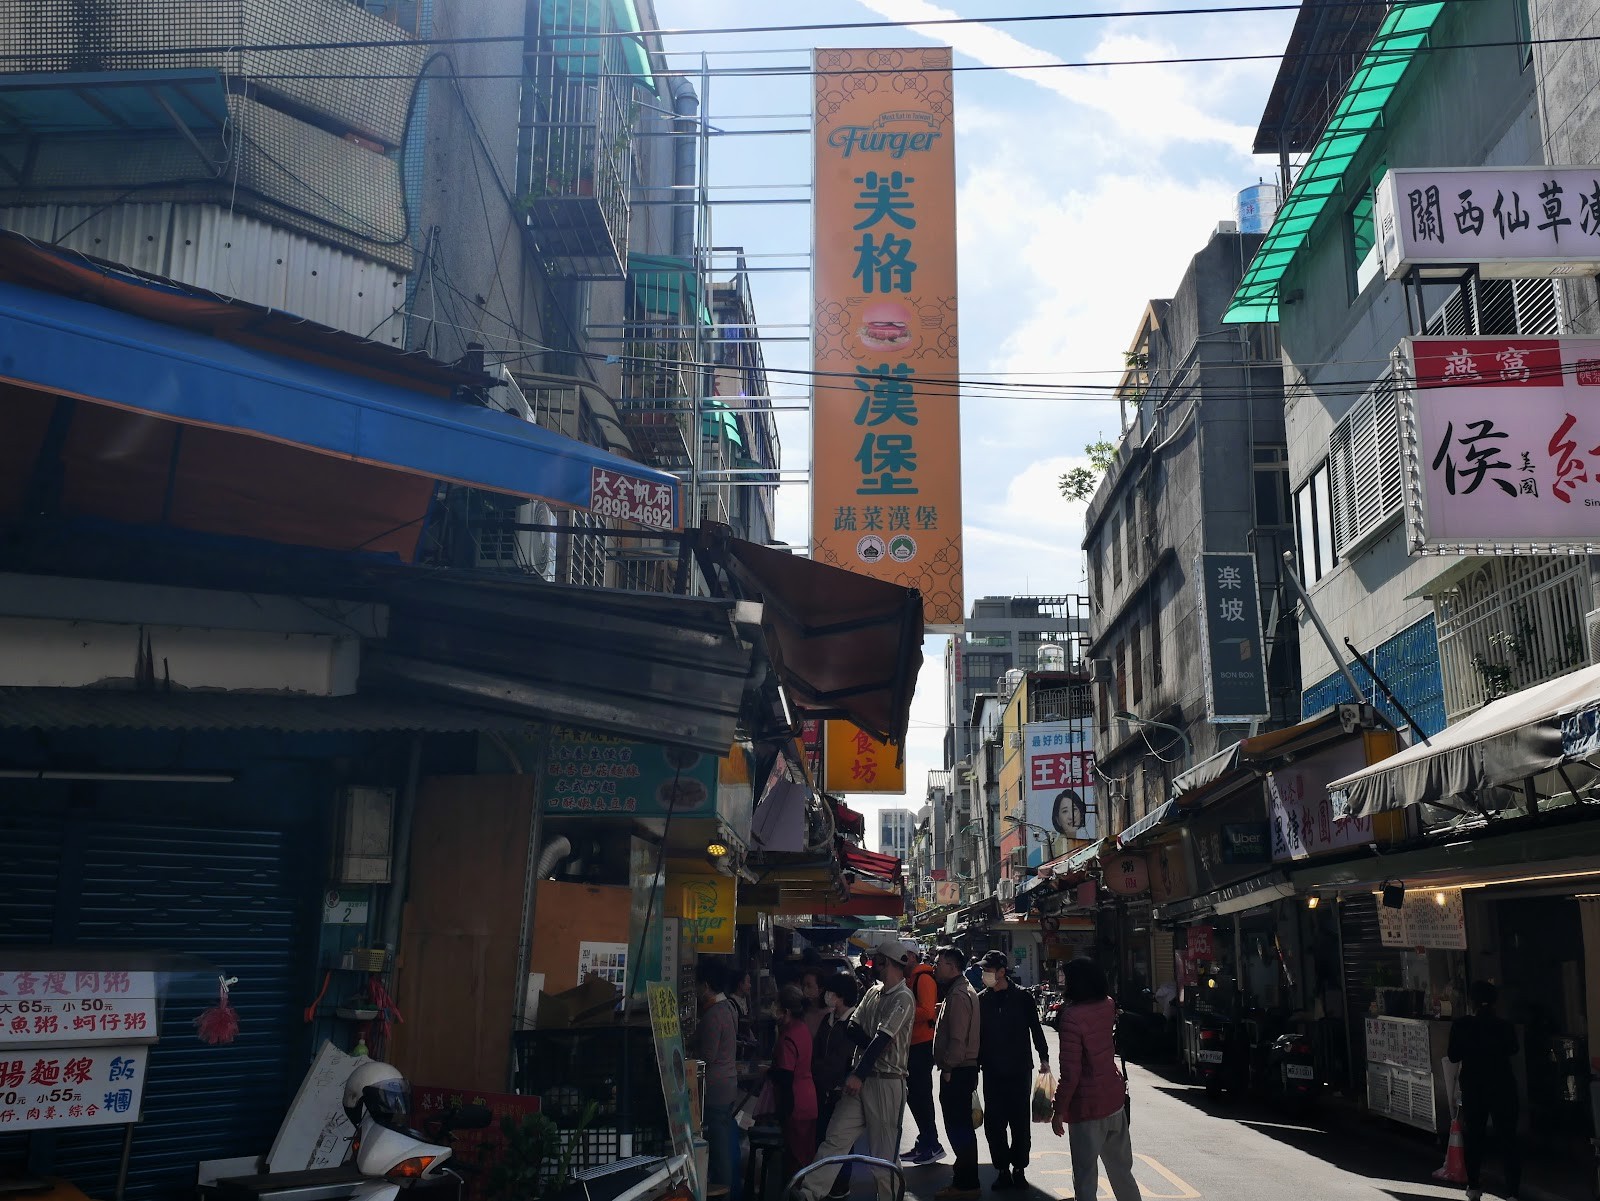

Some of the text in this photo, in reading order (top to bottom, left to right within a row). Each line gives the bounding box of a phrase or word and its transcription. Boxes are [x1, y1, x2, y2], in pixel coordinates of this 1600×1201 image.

[912, 113, 931, 121] Taiwan
[827, 124, 942, 159] Furger
[852, 170, 918, 294] 芙格
[853, 362, 919, 496] 漢堡
[593, 470, 671, 511] 大全帆布
[1518, 451, 1540, 499] 美國
[592, 494, 672, 528] 2898-4692
[833, 505, 939, 532] 蔬菜漢堡
[1220, 671, 1255, 680] BON BOX
[1031, 731, 1087, 747] 最好的選擇
[848, 729, 879, 784] 食坊
[1232, 833, 1261, 844] Uber
[342, 907, 352, 923] 2
[18, 1000, 53, 1013] 65元
[81, 999, 114, 1012] 50元
[103, 1056, 136, 1113] 飯糰
